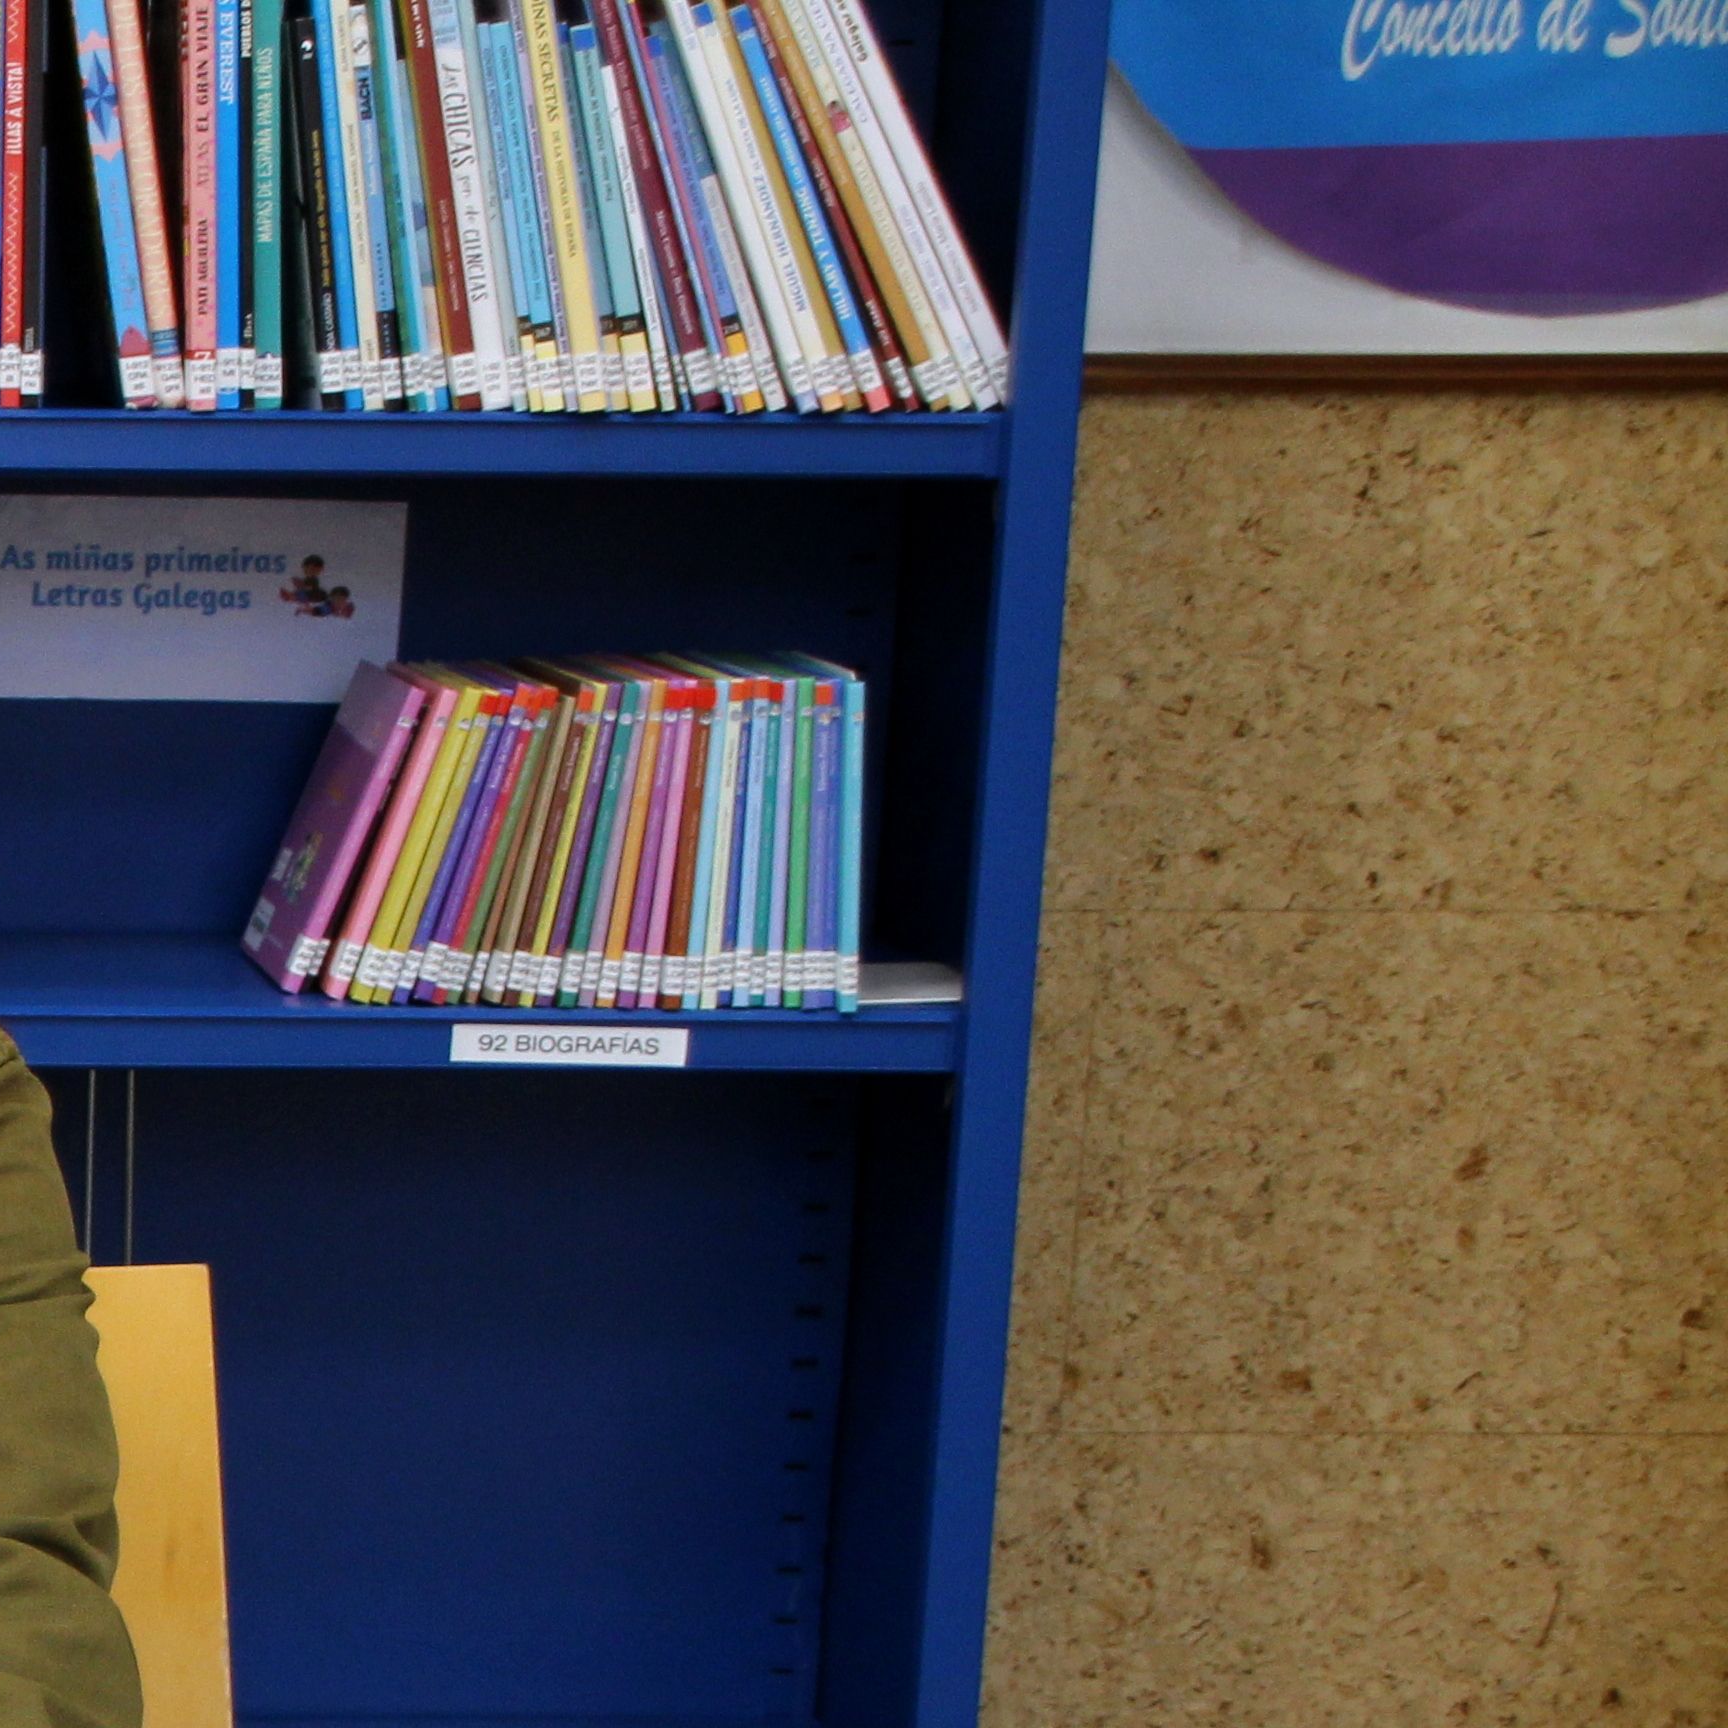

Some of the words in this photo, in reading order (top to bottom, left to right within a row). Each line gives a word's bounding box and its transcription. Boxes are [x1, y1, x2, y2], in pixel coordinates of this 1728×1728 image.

[219, 10, 236, 104] EVEREST
[0, 544, 36, 571] As
[46, 543, 135, 572] miñas
[144, 544, 288, 578] primeiras
[30, 580, 124, 609] Letras
[133, 582, 253, 616] Galegas
[477, 1033, 508, 1053] 92
[514, 1031, 661, 1056] BIOGRAFÍAS
